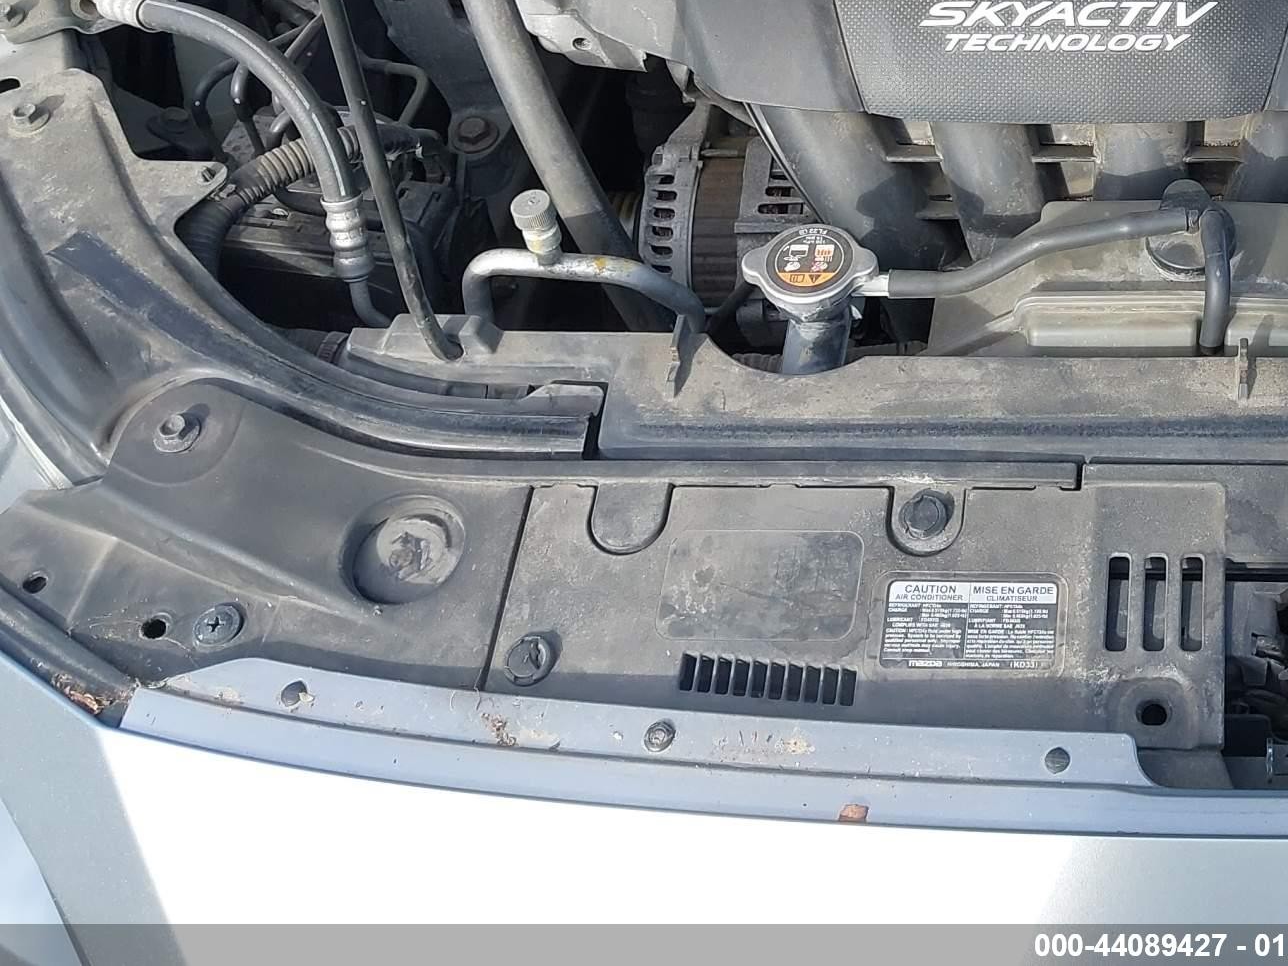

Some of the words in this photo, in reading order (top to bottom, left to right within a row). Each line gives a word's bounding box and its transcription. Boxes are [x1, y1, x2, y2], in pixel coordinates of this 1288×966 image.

[918, 1, 1219, 27] SKYACTIV
[944, 34, 1192, 52] TECHNOLOGY
[904, 584, 957, 594] CAUTION
[973, 586, 998, 594] MISE
[1001, 586, 1015, 595] EN
[1017, 586, 1054, 595] GARDE
